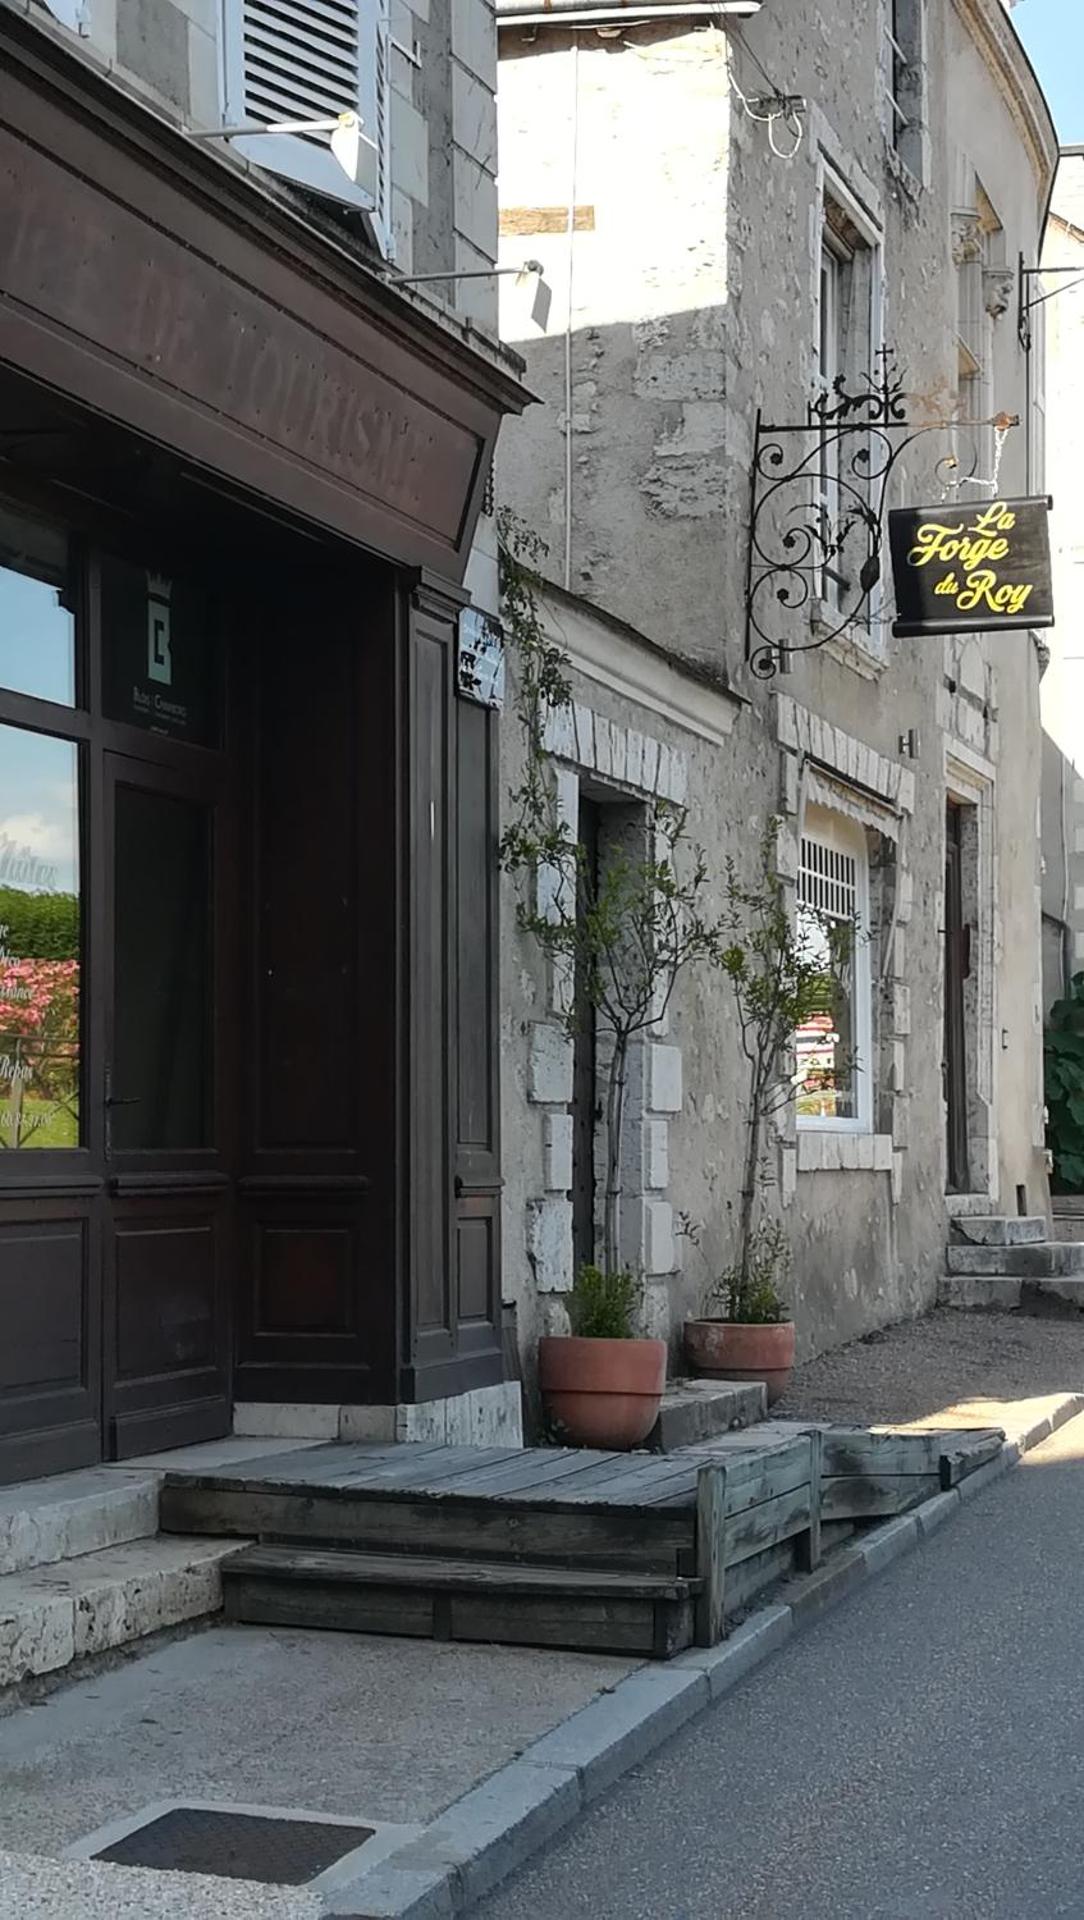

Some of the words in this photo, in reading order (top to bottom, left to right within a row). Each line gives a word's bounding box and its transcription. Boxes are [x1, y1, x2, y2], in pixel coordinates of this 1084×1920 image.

[967, 501, 1016, 537] La
[907, 523, 1009, 571] Forge
[934, 572, 958, 595] du
[956, 569, 1033, 614] Roy
